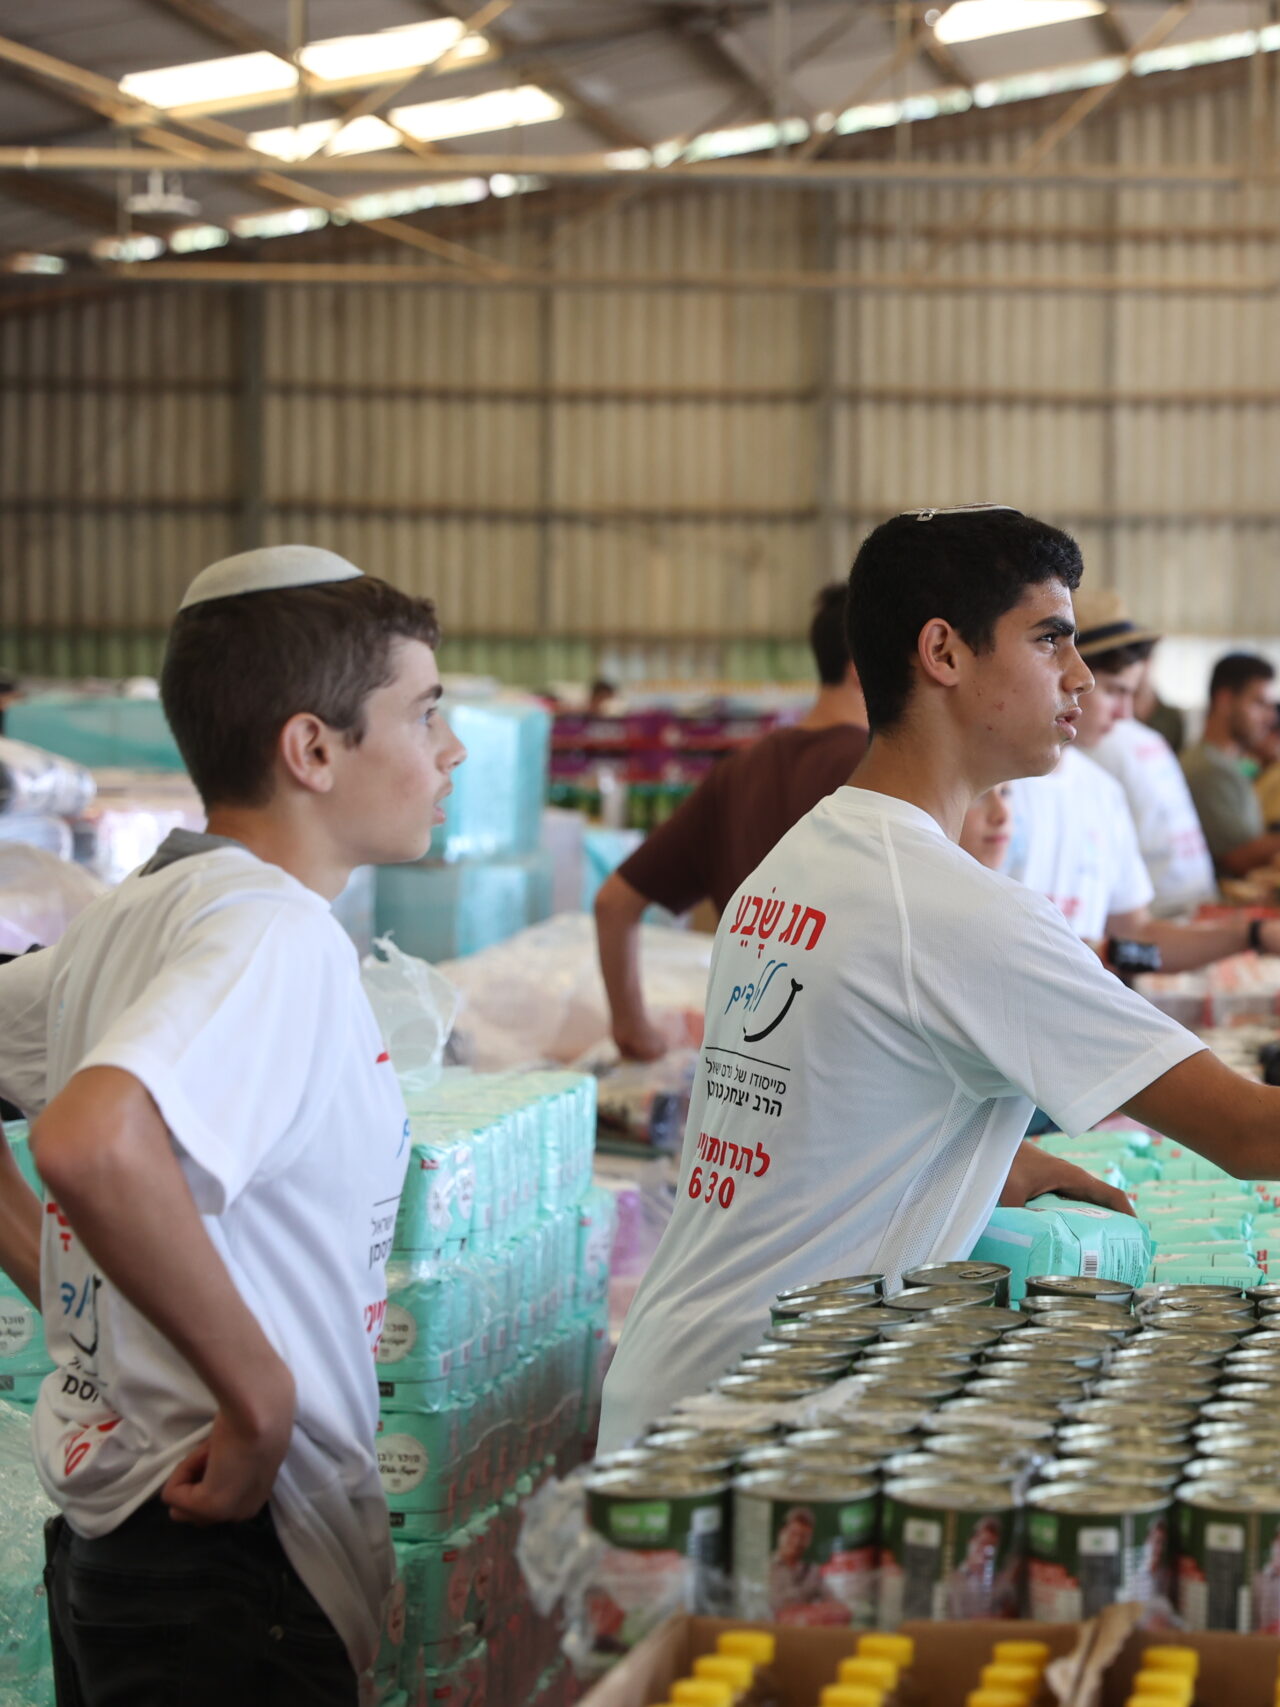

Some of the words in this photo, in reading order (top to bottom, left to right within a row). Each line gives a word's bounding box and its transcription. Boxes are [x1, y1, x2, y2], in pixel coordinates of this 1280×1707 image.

[778, 903, 827, 951] חג
[734, 1065, 748, 1083] של
[749, 1073, 787, 1095] מייסודו
[752, 1095, 782, 1117] הרב
